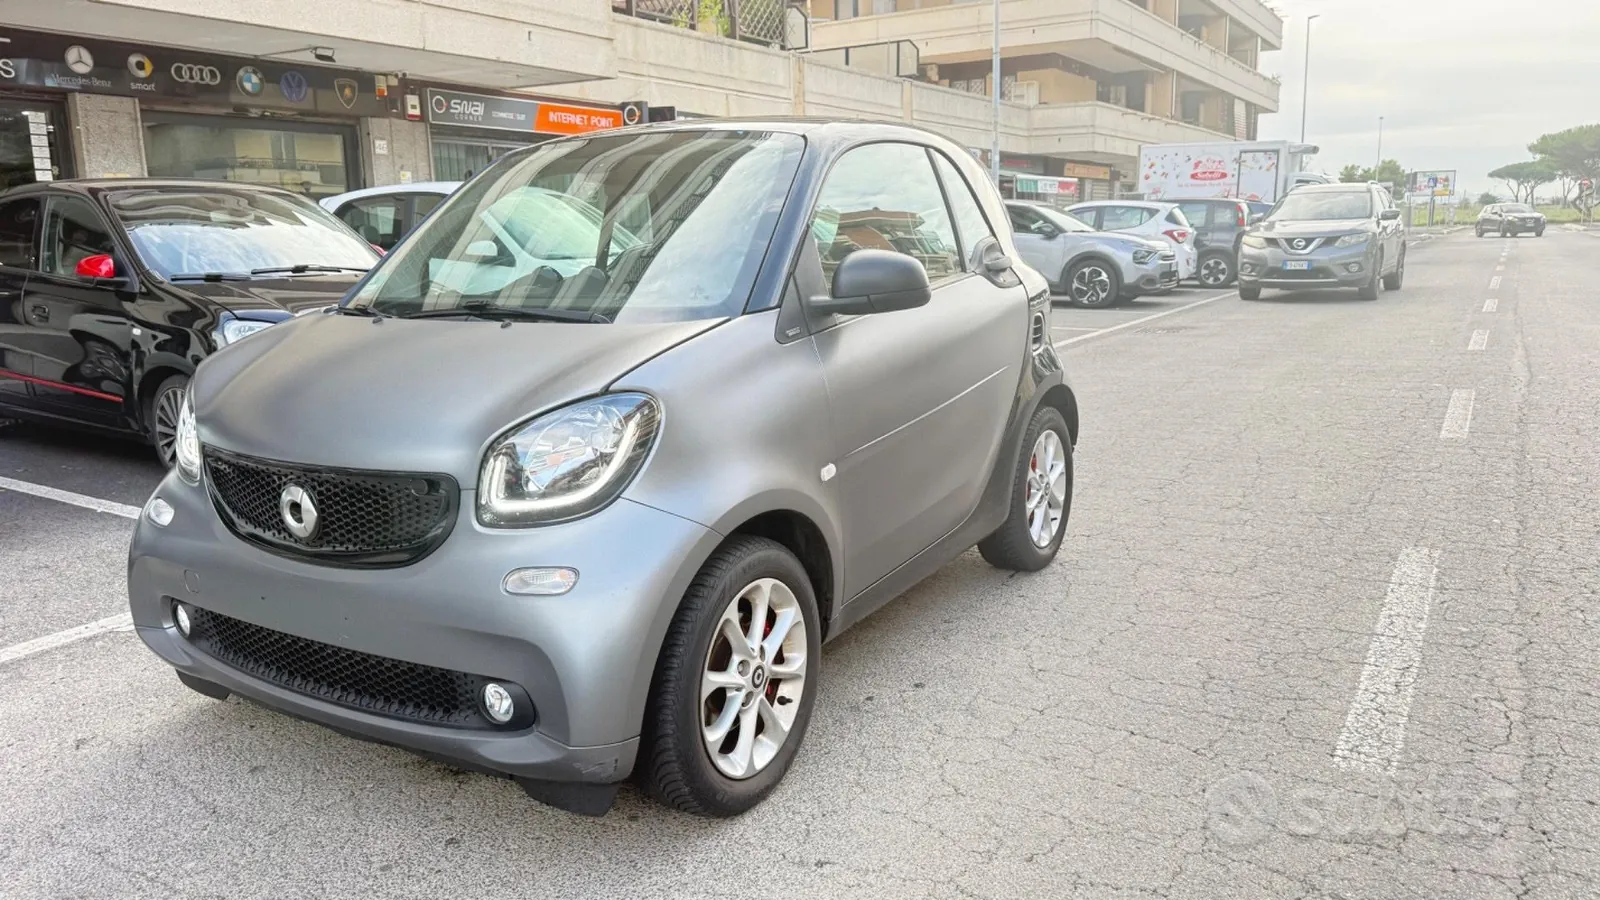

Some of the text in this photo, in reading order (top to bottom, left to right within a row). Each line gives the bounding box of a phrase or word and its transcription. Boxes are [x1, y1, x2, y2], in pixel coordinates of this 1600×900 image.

[52, 73, 112, 88] Mercedes-Benz
[130, 81, 156, 92] smart
[548, 111, 588, 127] INTERNET
[590, 115, 614, 128] POINT
